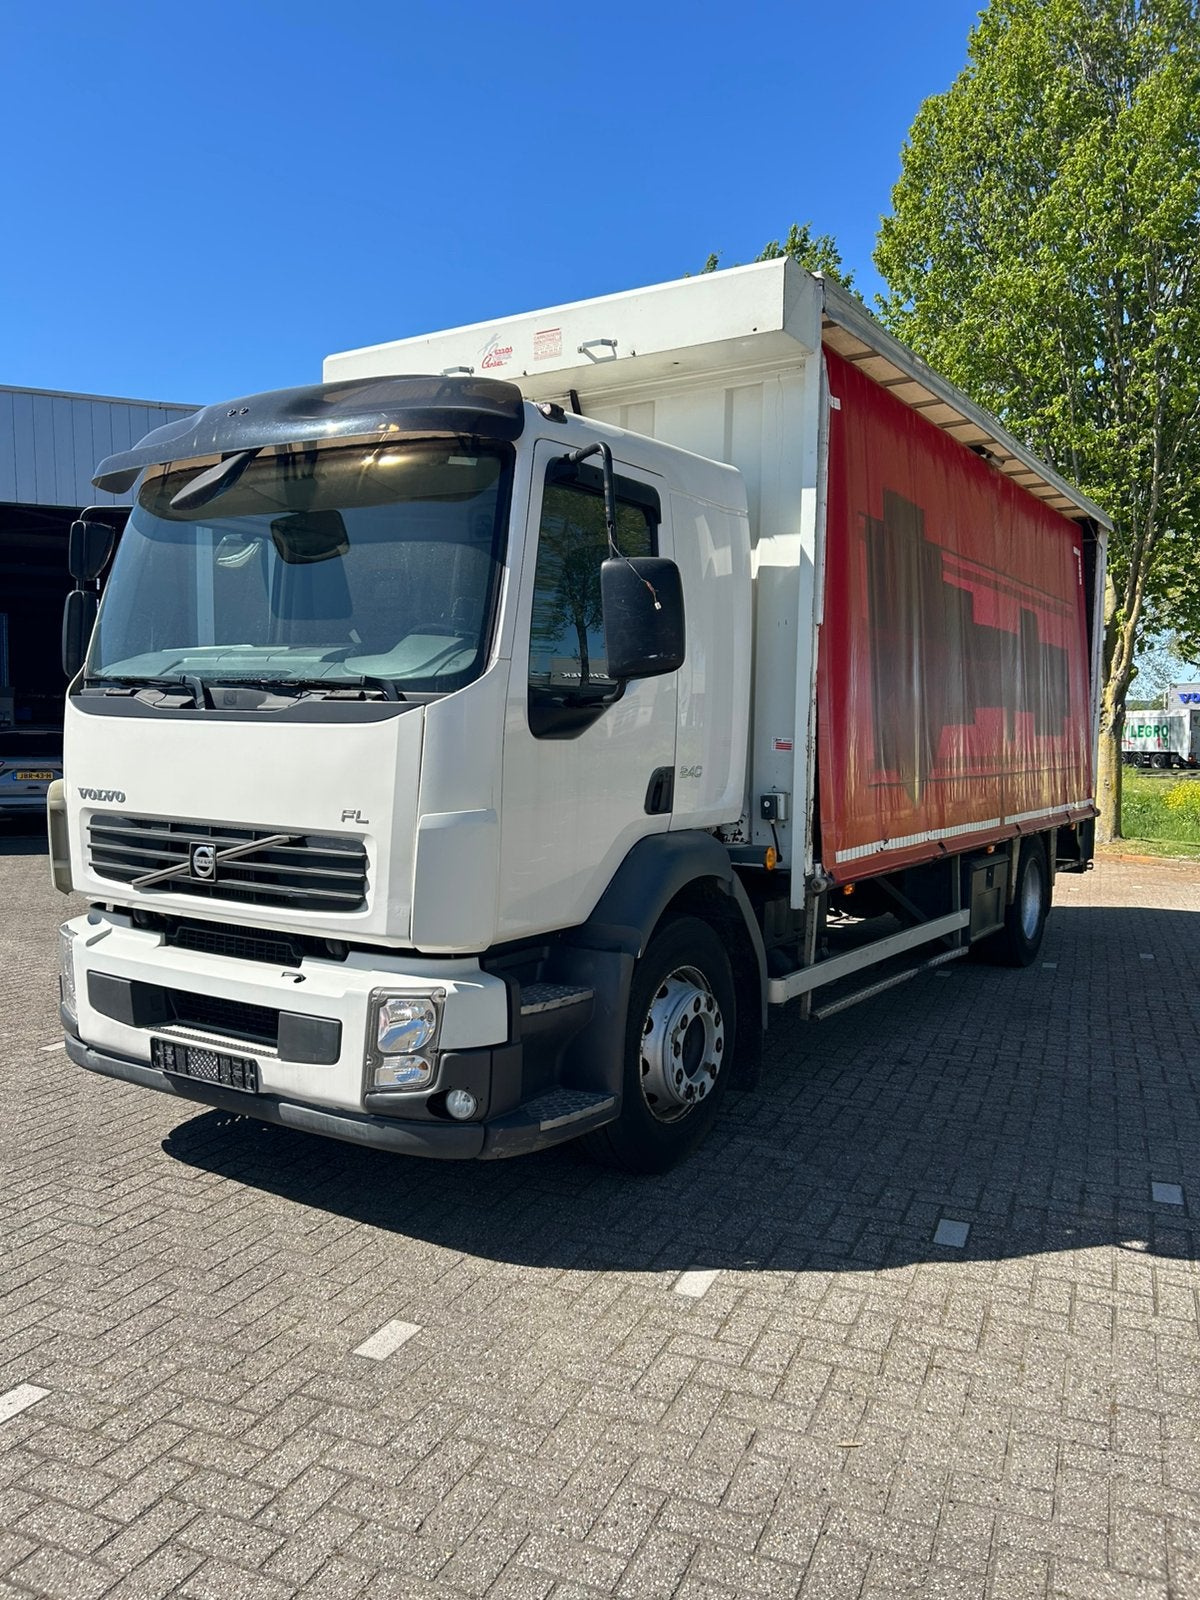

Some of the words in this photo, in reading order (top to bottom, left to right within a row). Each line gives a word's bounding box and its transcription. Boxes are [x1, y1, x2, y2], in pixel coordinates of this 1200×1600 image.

[1130, 725, 1169, 738] LEGRO
[77, 787, 126, 803] VOLVO
[340, 809, 370, 824] FL
